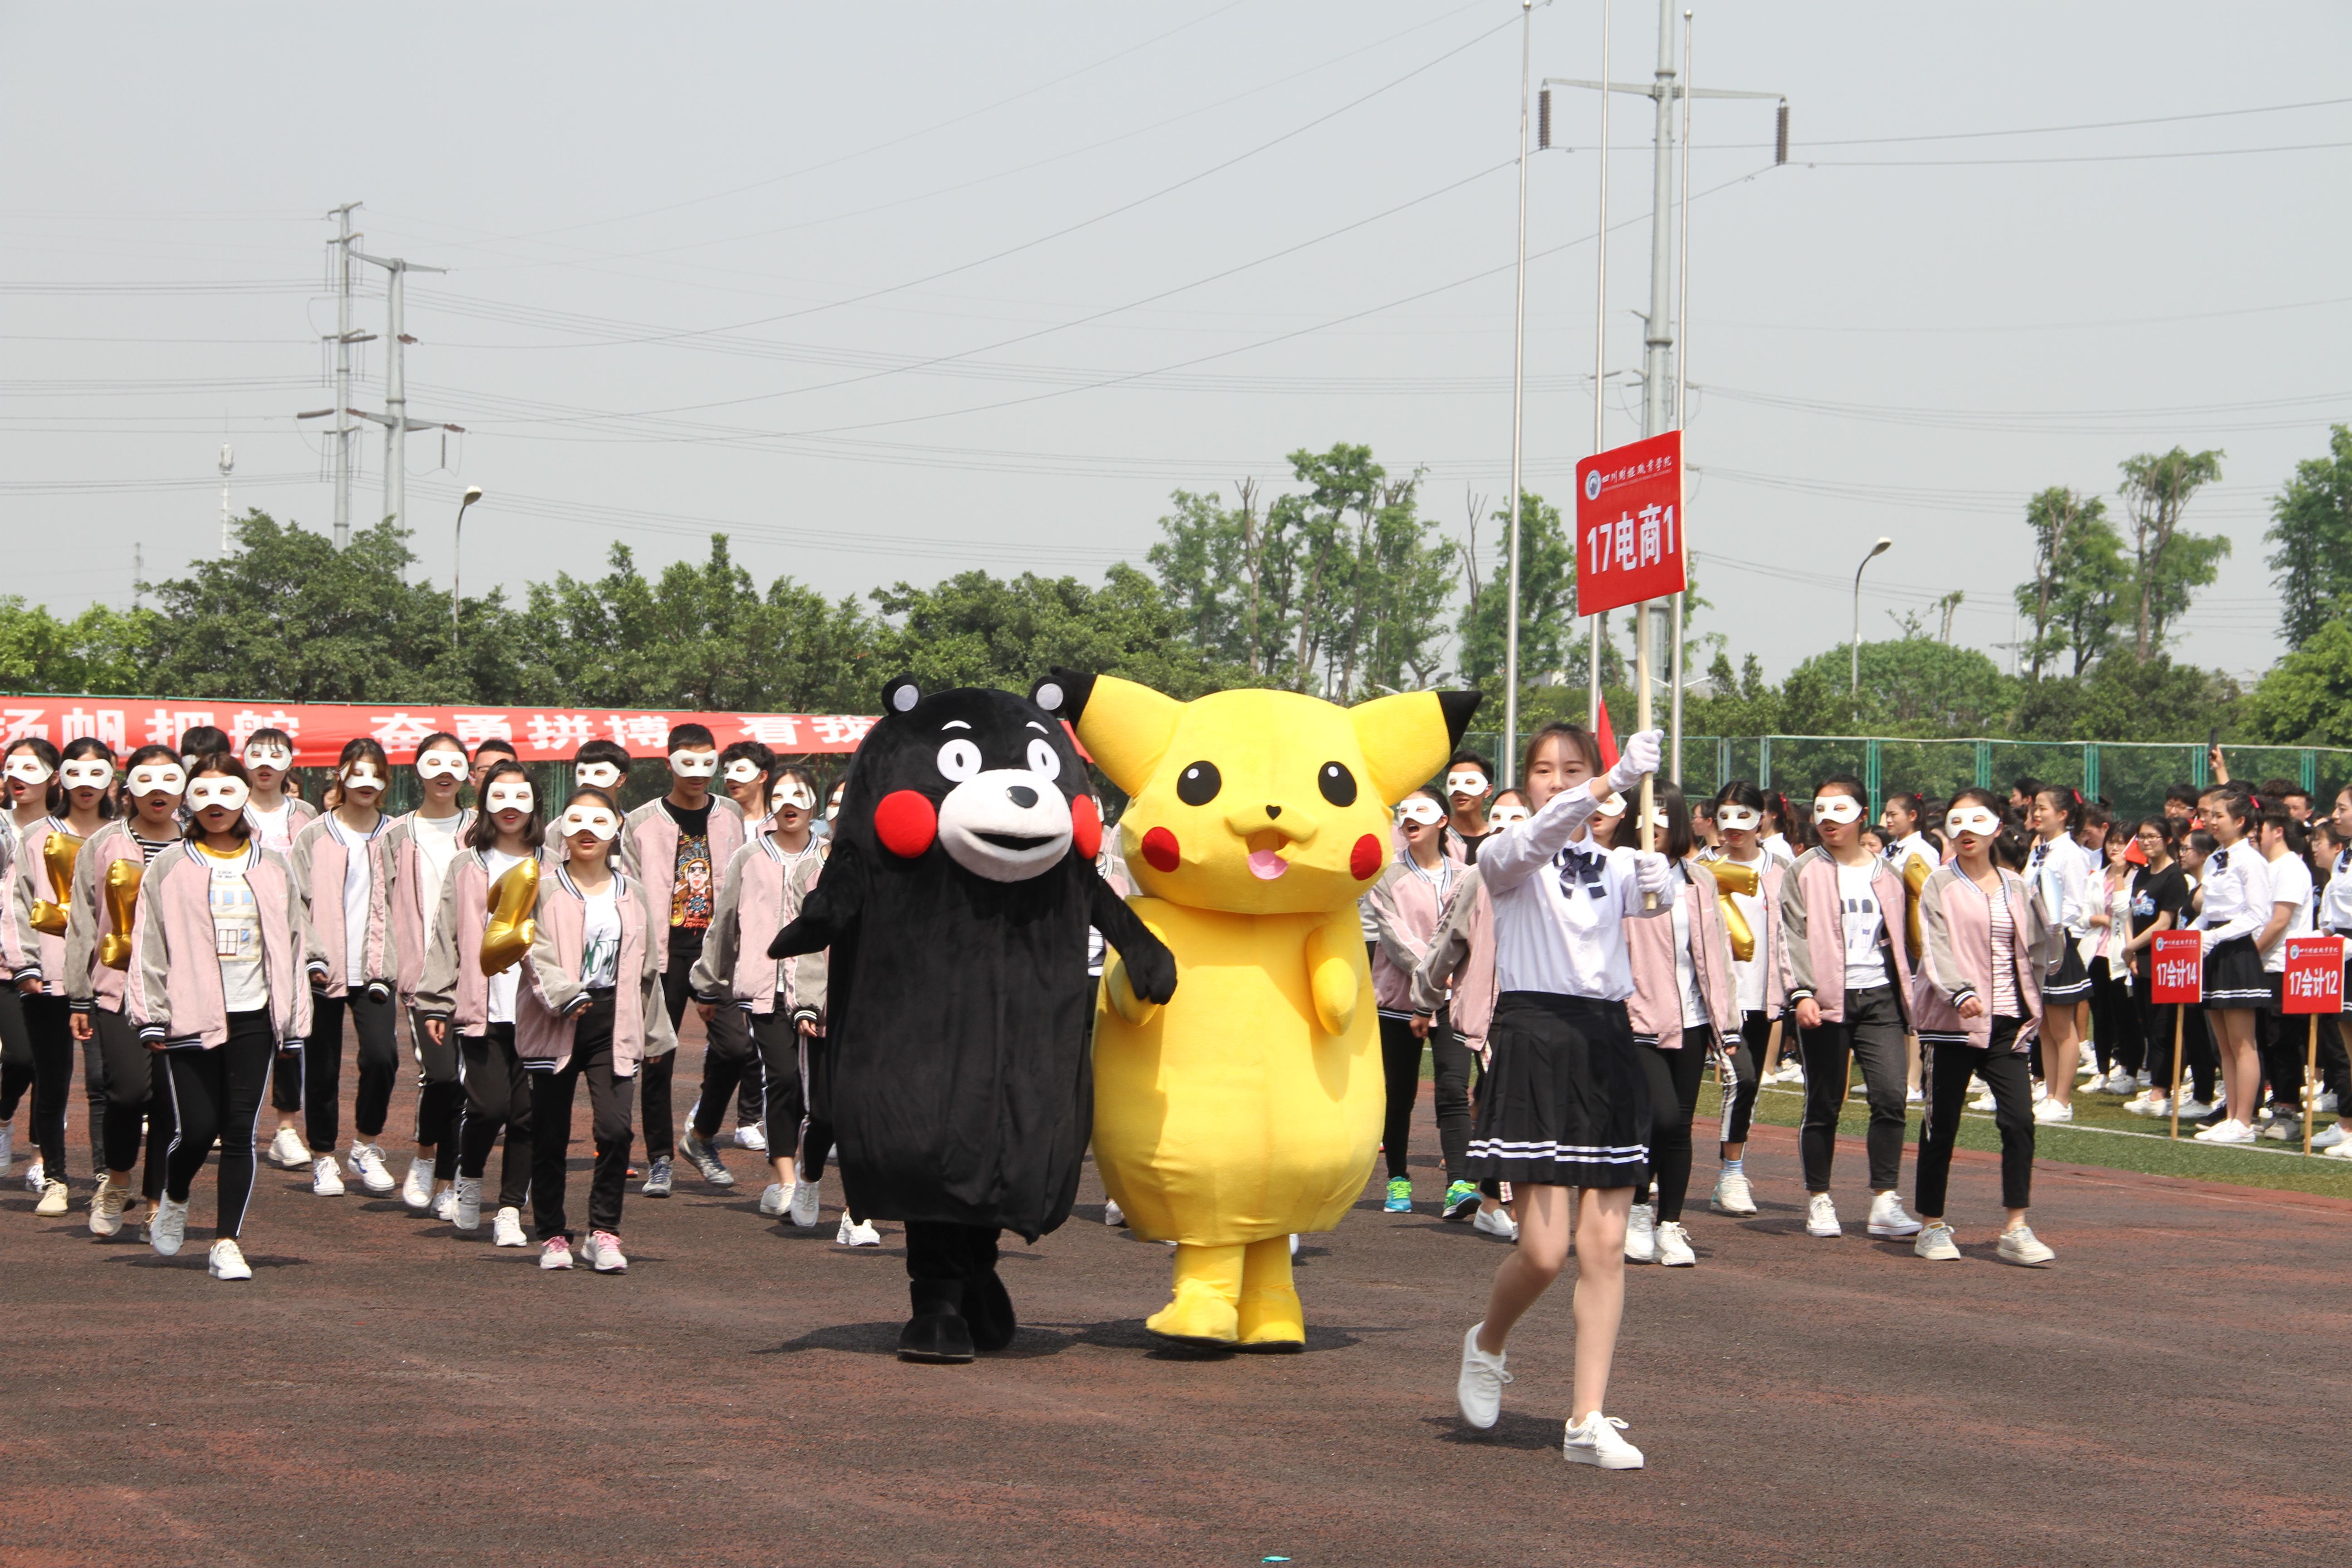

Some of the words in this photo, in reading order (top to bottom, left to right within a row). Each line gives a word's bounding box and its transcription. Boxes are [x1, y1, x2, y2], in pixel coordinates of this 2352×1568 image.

[1587, 502, 1674, 575] 17电商1
[370, 712, 670, 754] 奋勇拼搏
[2156, 959, 2197, 988] 17会计14
[2289, 967, 2338, 997] 17会计12
